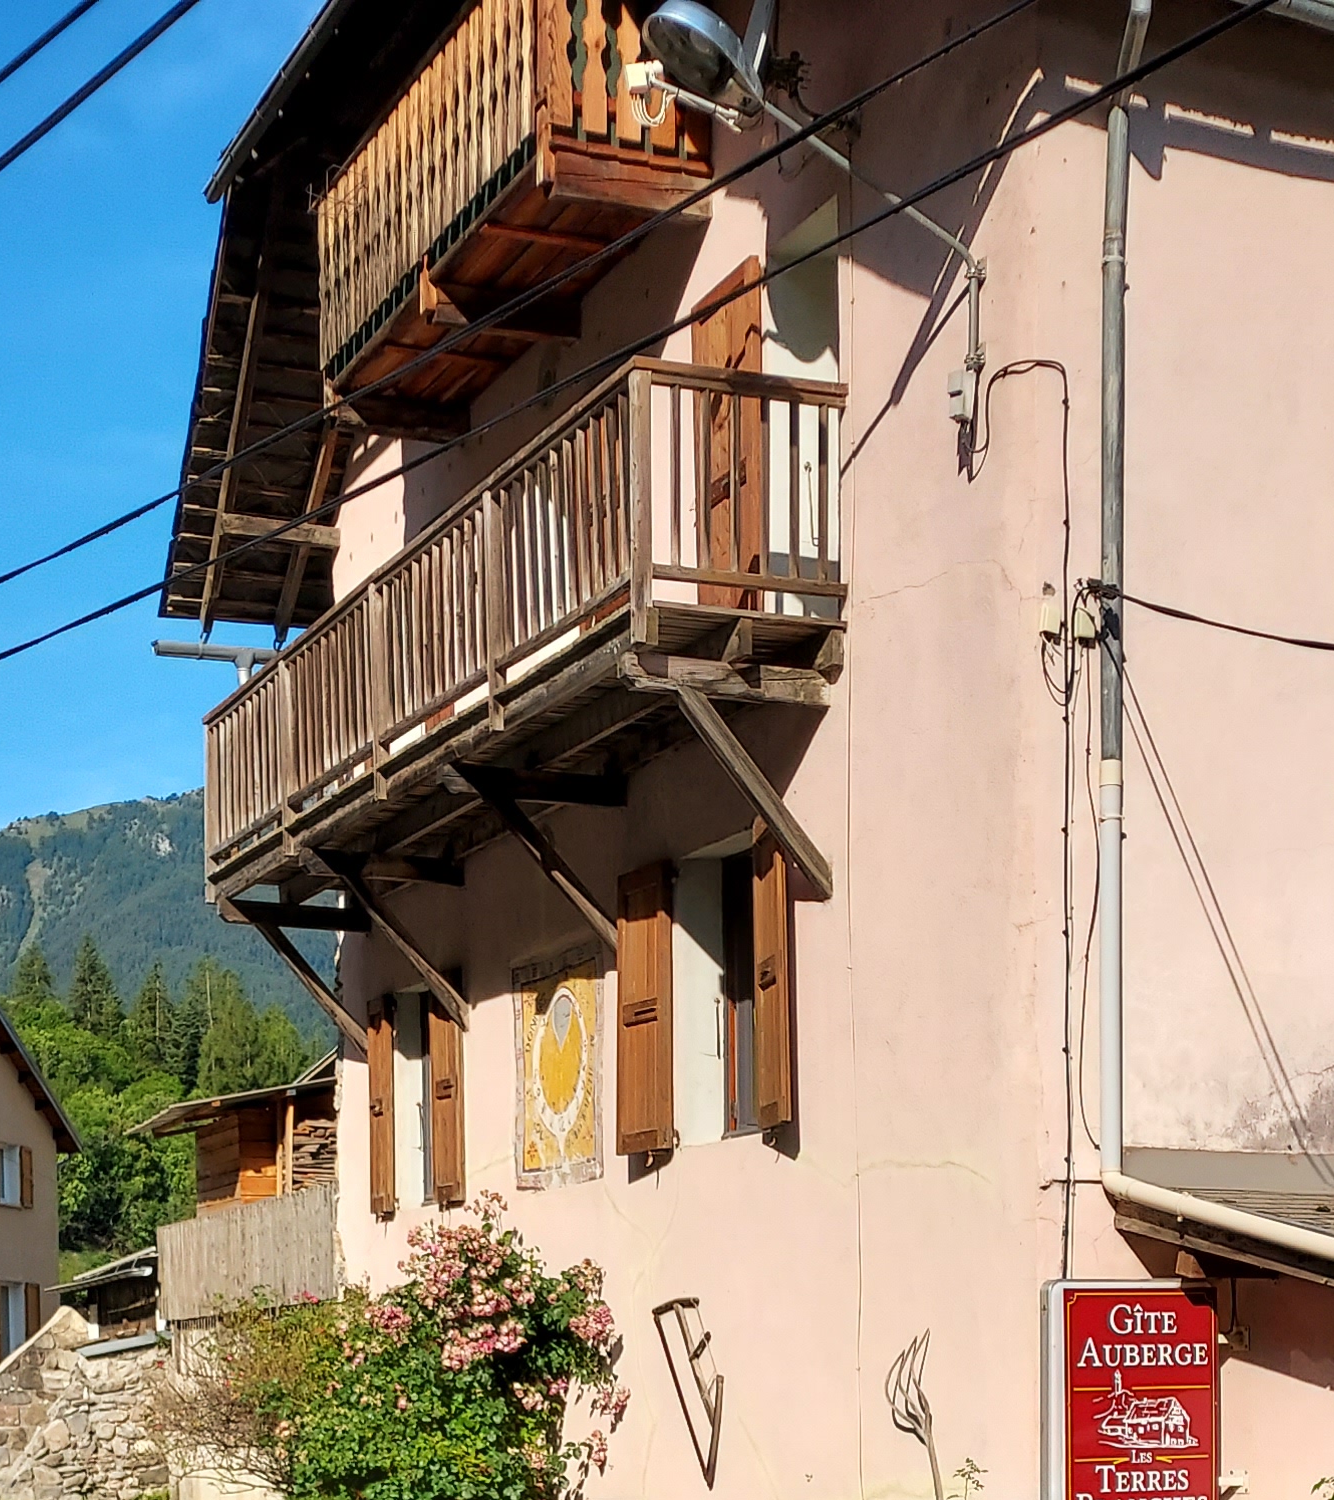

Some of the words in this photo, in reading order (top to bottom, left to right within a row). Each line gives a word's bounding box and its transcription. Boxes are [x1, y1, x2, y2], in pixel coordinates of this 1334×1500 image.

[1108, 1304, 1177, 1335] GÎTE
[1077, 1337, 1208, 1367] AUBERGE
[1095, 1464, 1189, 1494] TERRES
